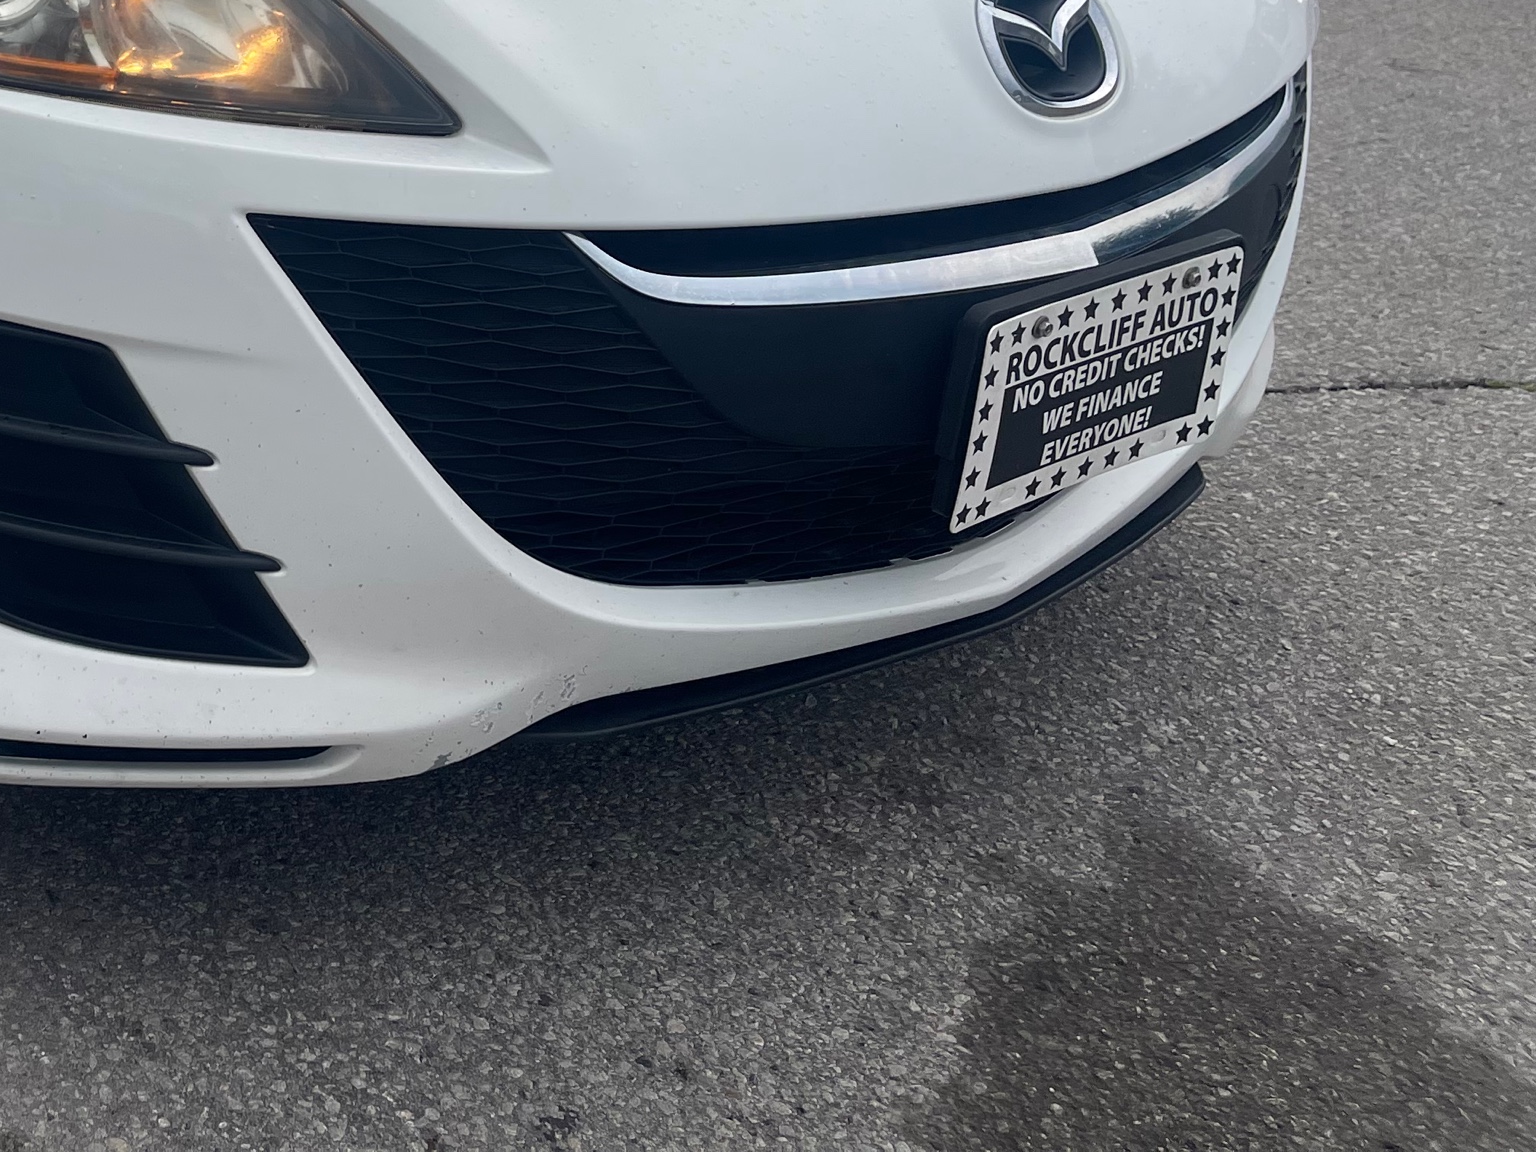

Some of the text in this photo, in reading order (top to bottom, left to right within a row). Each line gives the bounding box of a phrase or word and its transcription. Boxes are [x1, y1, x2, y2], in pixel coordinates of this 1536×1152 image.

[1005, 287, 1219, 386] ROCKCLIFF AUTO
[1012, 324, 1206, 413] NO CREDIT CHECKS!
[1039, 406, 1153, 466] EVERYONE!
[1041, 370, 1164, 434] WE FINANCE
